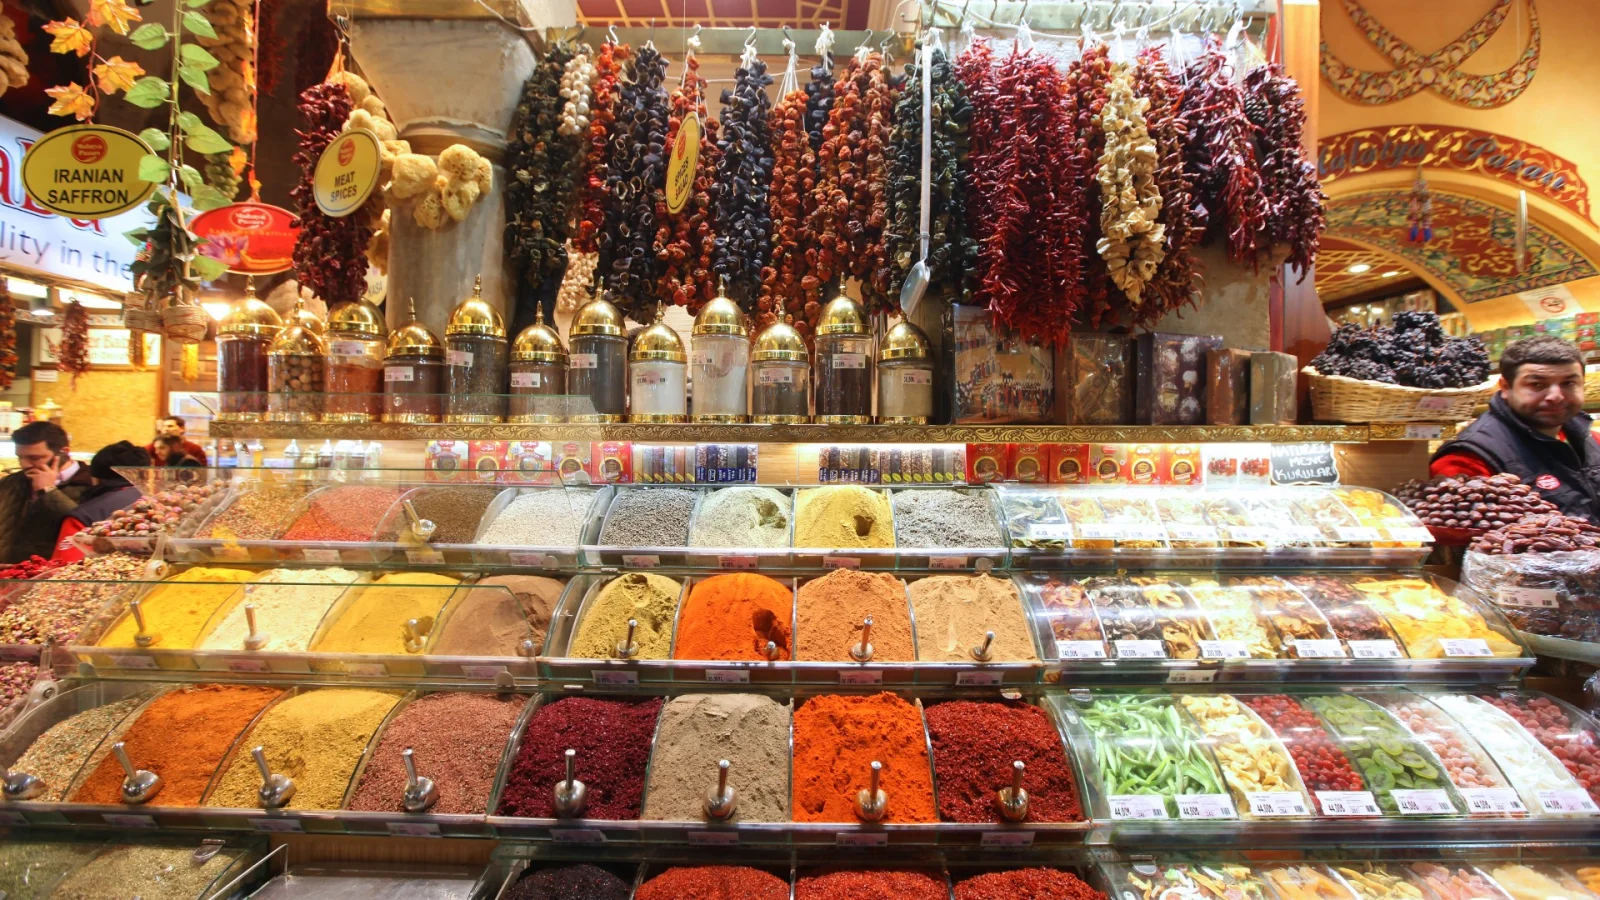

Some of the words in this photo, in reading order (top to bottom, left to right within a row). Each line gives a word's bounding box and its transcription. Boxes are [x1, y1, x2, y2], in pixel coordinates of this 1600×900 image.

[54, 168, 124, 183] IRANIAN
[334, 171, 355, 188] MEAT
[48, 189, 129, 204] SAFFRON
[331, 185, 357, 202] SPICES
[61, 240, 82, 268] in
[92, 251, 133, 280] the
